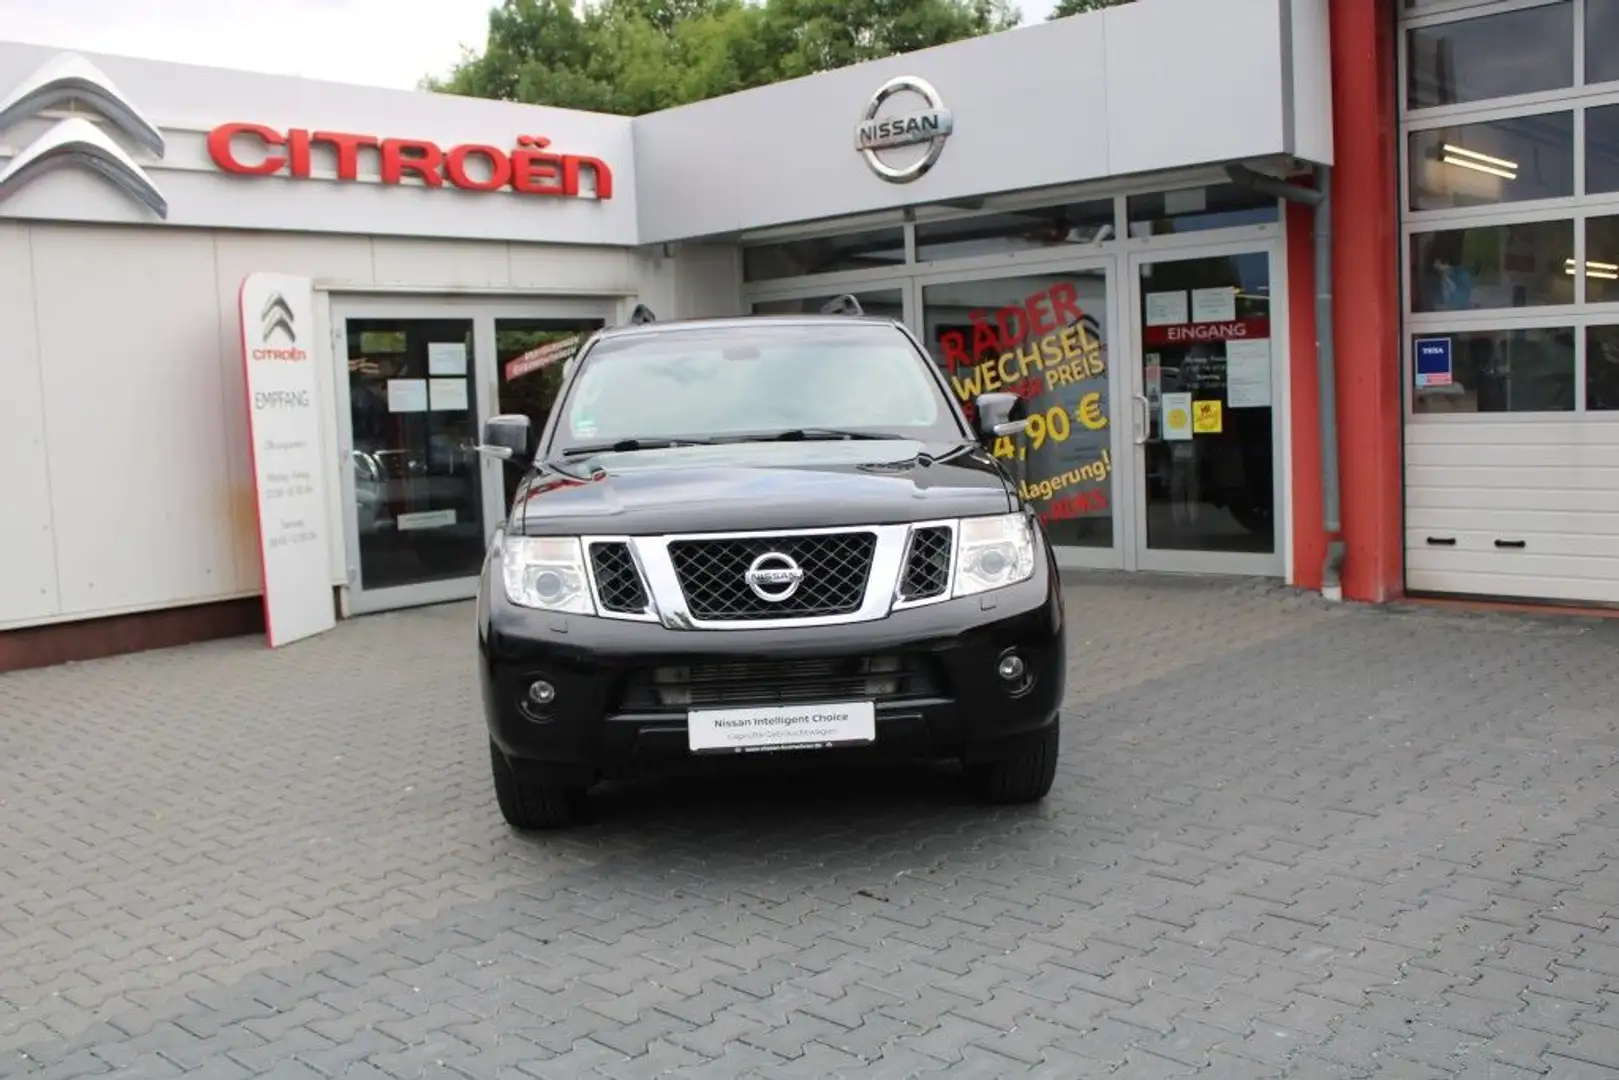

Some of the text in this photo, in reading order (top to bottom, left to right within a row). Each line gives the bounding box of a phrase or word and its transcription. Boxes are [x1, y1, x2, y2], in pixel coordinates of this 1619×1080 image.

[860, 114, 939, 142] NISSAN
[206, 121, 613, 200] CITROËN
[939, 281, 1085, 373] RÄDER
[1167, 322, 1247, 340] EINGANG
[951, 318, 1100, 401] WECHSEL
[1045, 351, 1105, 392] PREIS
[255, 389, 309, 410] EMPFANG
[1075, 392, 1108, 430] €
[714, 712, 849, 728] Nissan Intelligent Choice
